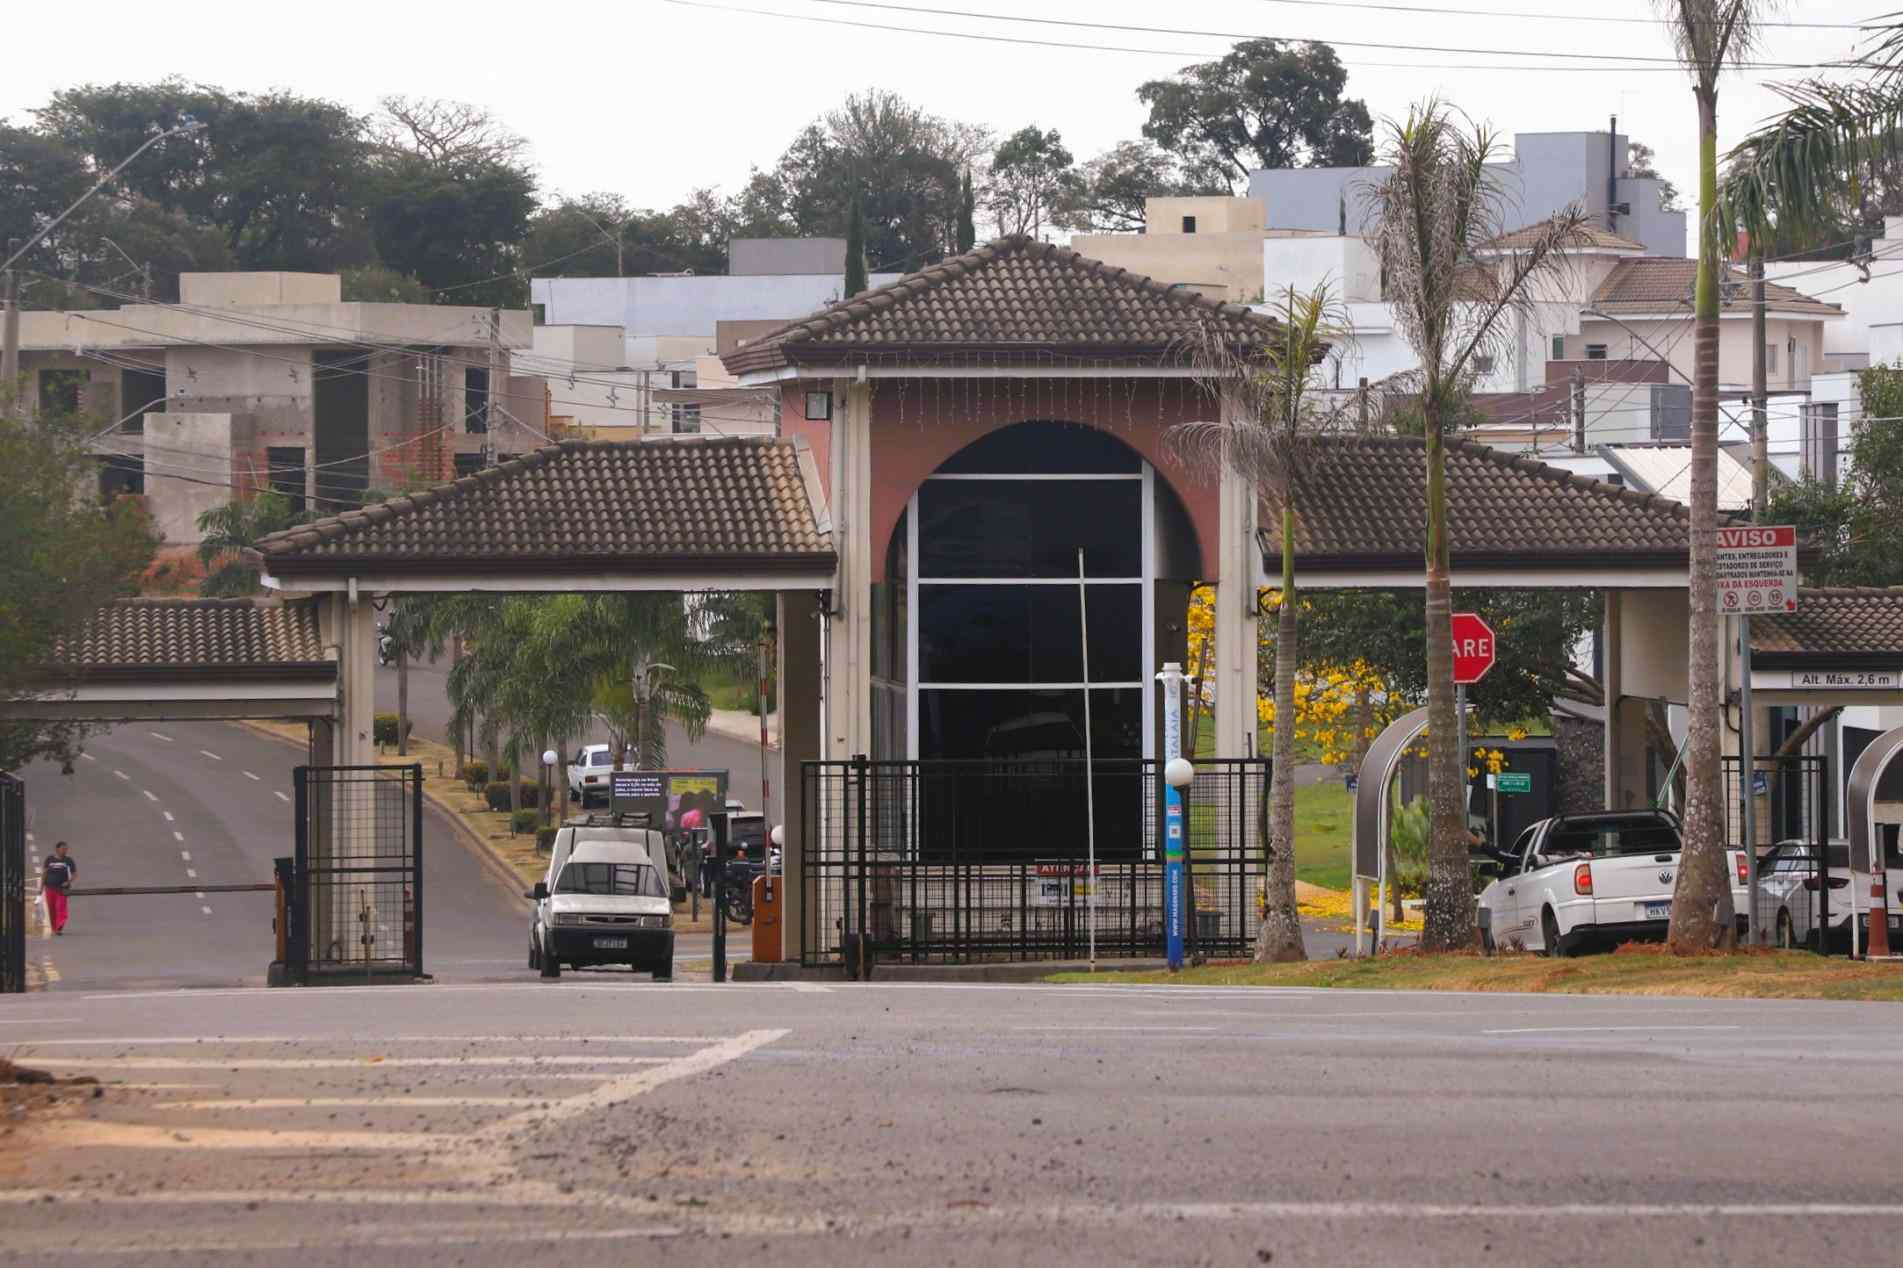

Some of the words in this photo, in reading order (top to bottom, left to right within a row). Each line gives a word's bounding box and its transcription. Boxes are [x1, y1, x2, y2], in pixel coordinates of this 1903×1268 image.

[1715, 530, 1777, 546] AVISO
[1732, 580, 1743, 589] DA
[1744, 578, 1784, 588] ESQUERDA
[1451, 638, 1489, 658] ARE
[1802, 674, 1821, 685] Alt.
[1857, 674, 1875, 687] 2,6
[1878, 676, 1890, 685] m
